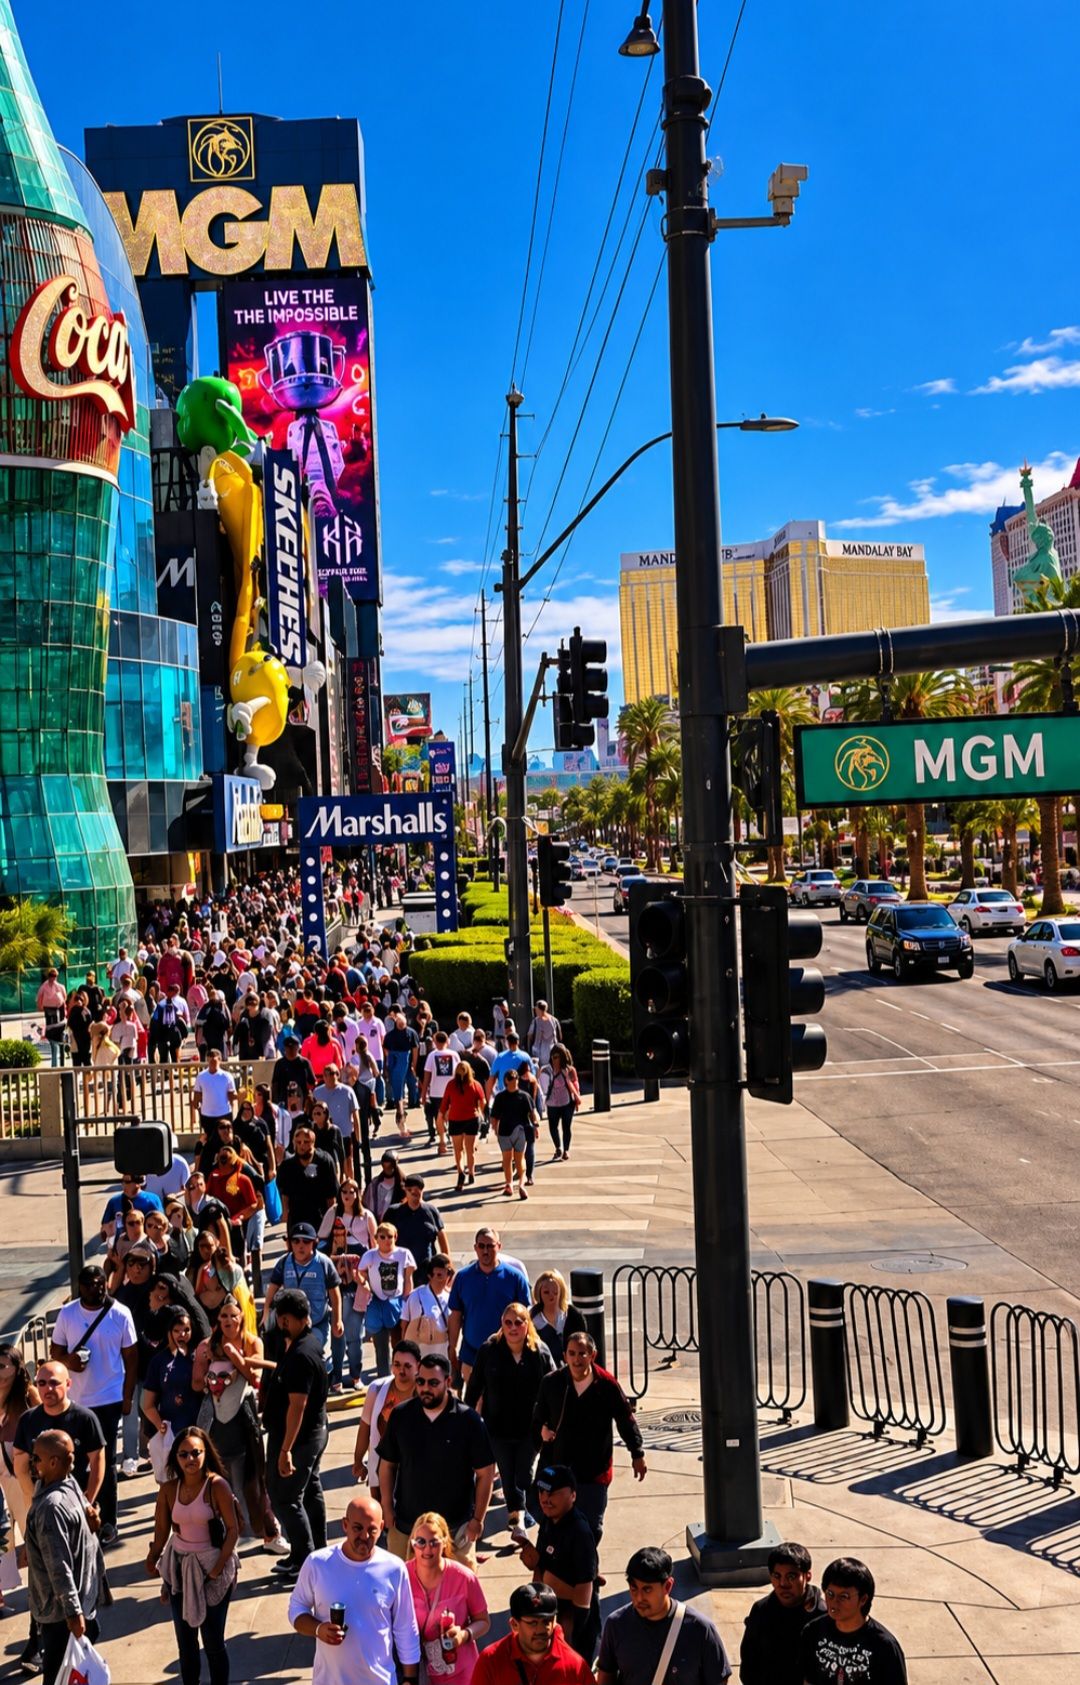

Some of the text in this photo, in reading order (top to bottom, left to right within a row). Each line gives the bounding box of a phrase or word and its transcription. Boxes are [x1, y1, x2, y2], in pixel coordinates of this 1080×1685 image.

[104, 184, 367, 276] MGM
[234, 305, 358, 325] THE IMPOSSIBLE
[264, 288, 335, 306] LIVE THE
[18, 274, 130, 422] Coca
[842, 544, 913, 558] MANDALAY BAY
[914, 732, 1045, 784] MGM
[304, 802, 447, 838] Marshalls
